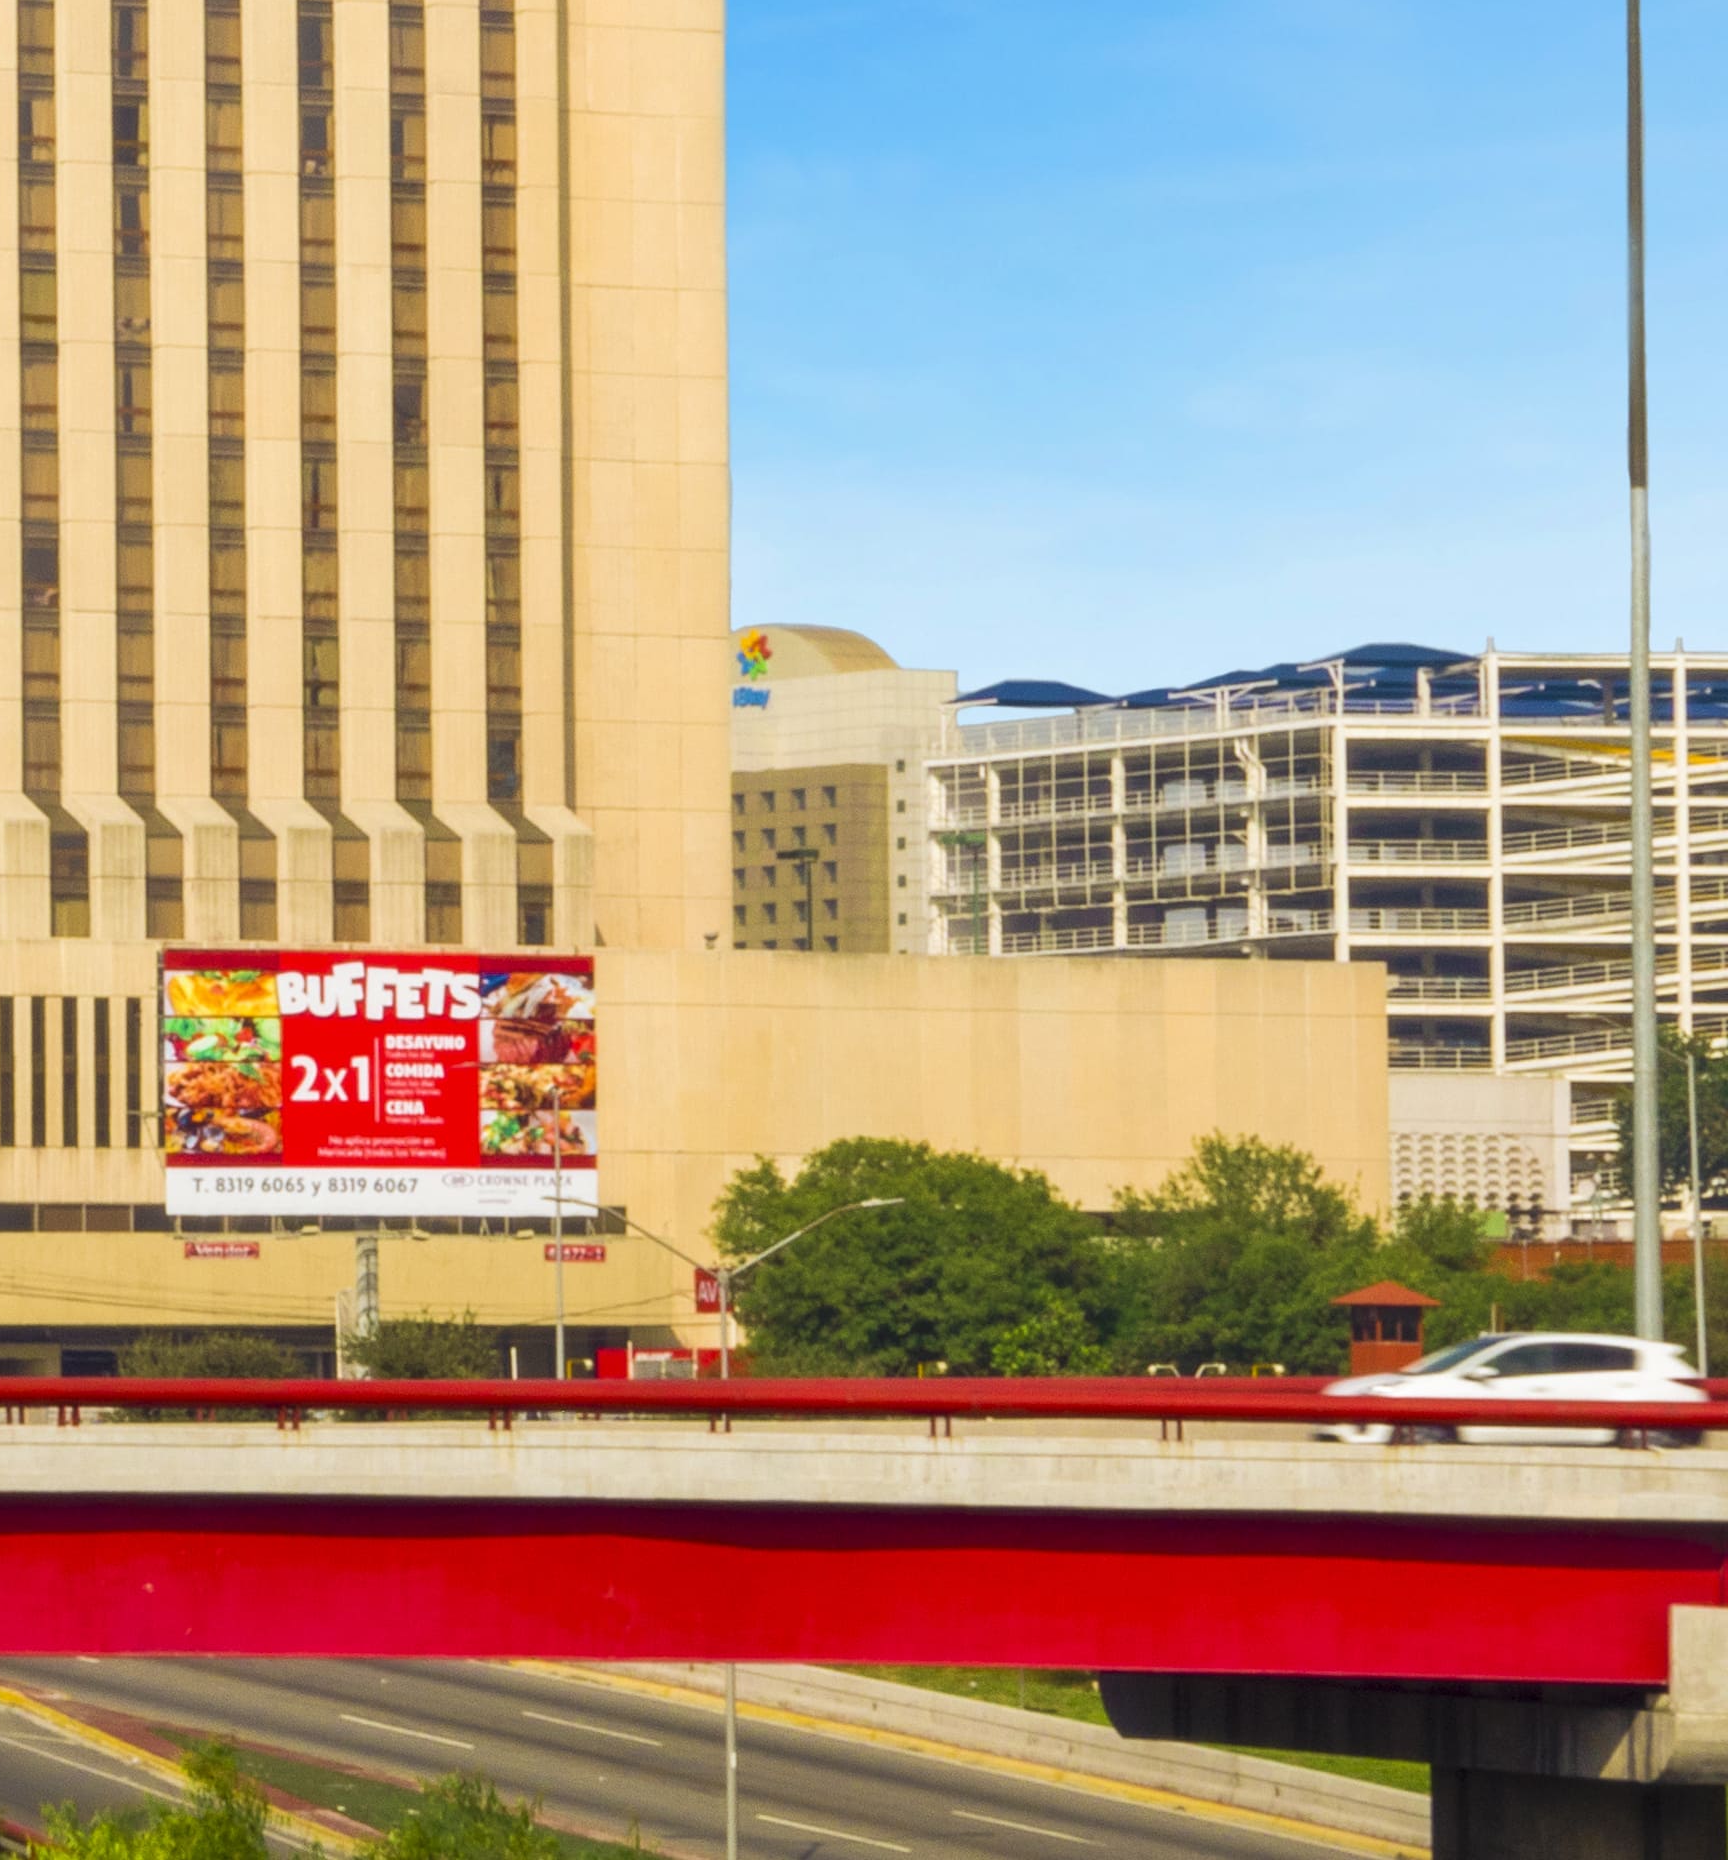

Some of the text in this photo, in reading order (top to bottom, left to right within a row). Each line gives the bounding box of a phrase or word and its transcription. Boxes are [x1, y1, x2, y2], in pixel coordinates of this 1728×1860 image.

[277, 962, 482, 1020] BUFFETS
[385, 1034, 466, 1051] DESAYUNO
[290, 1054, 370, 1102] 2x1
[385, 1062, 445, 1079] COMIDA
[385, 1100, 425, 1116] CENA
[193, 1177, 418, 1196] T. 8319 6065 y 8319 6067
